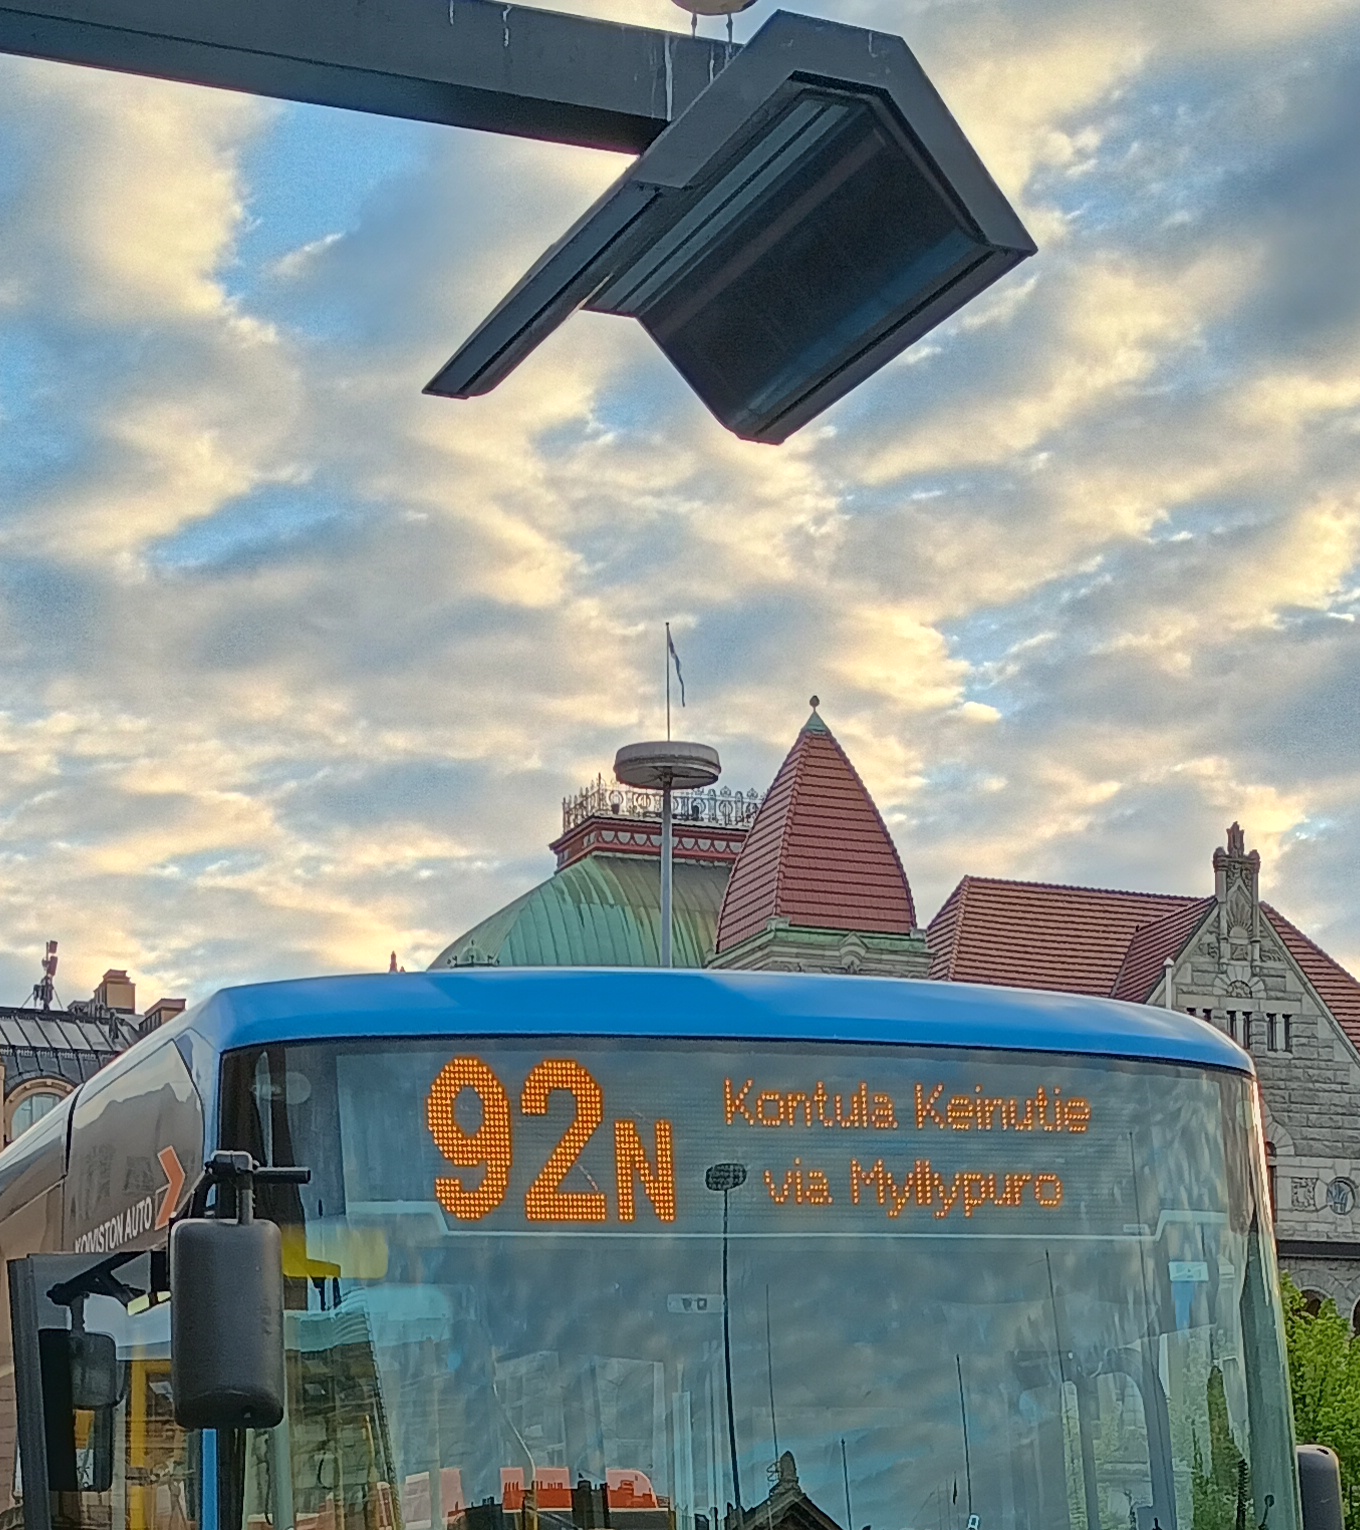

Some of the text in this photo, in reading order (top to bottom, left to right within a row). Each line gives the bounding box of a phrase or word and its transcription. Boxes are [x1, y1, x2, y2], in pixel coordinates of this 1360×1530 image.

[723, 1077, 1092, 1134] Kontula Keinutie
[424, 1055, 678, 1223] 92N
[762, 1157, 1065, 1220] via Myllypuro
[125, 1196, 153, 1243] AUTO
